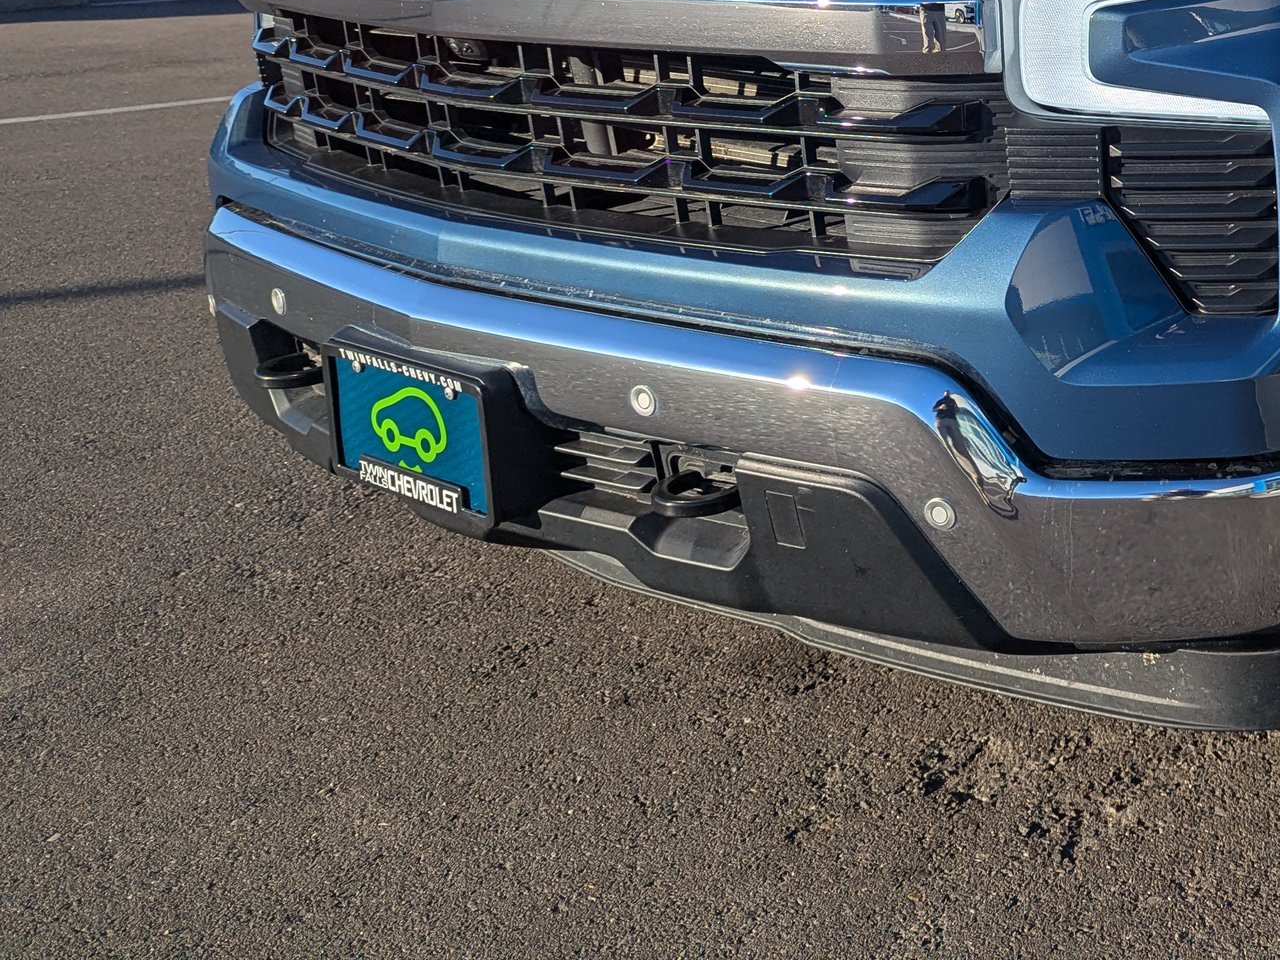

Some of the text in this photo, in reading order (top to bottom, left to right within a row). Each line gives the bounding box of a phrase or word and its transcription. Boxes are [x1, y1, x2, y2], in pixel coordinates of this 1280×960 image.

[338, 348, 463, 393] TWINFALLS-CHEVY.COM
[359, 460, 388, 480] TWIN
[360, 470, 389, 489] FALLS
[387, 469, 459, 514] CHEVROLET
